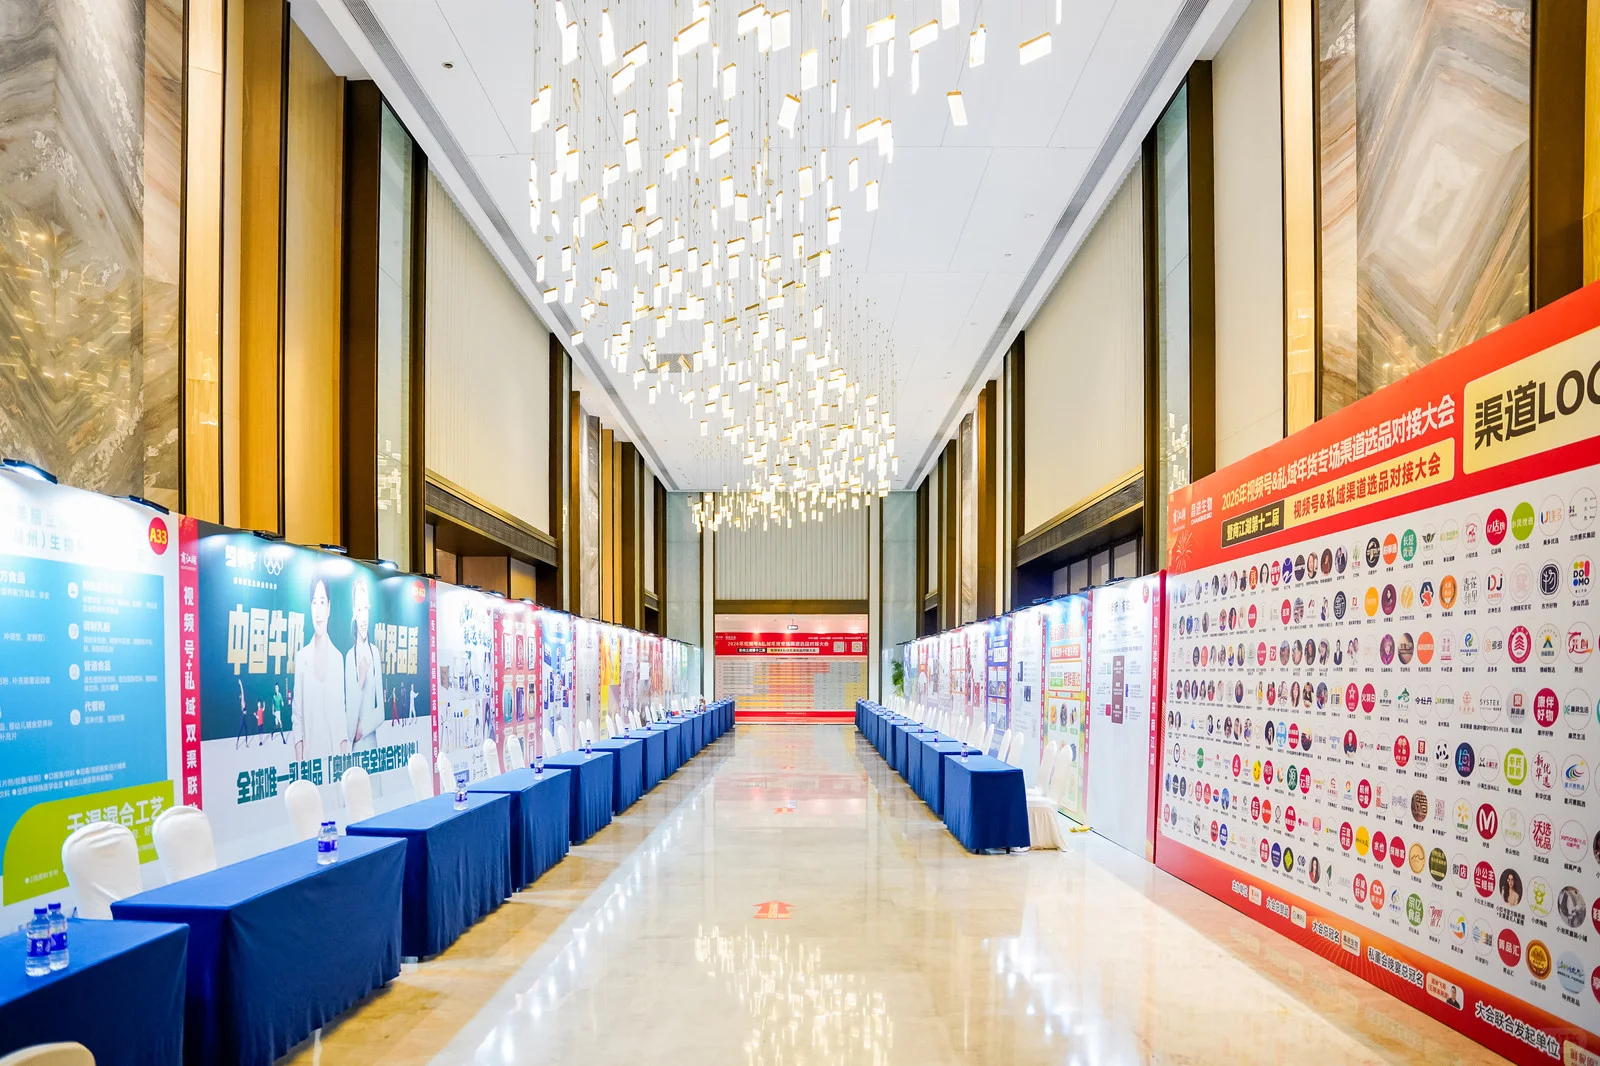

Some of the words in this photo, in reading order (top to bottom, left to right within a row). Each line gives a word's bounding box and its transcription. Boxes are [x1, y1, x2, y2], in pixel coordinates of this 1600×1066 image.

[1222, 394, 1455, 511] 2026年视频号&私域年货专场渠道选品对接大会
[1294, 452, 1441, 520] 视频号&私域渠道选品对接大会
[150, 527, 167, 545] A33
[1226, 508, 1280, 541] 暨商江湖第十二届
[227, 604, 305, 675] 中国牛奶
[183, 586, 199, 810] 视频号+私域双渠联
[1537, 709, 1554, 722] 好物
[1535, 793, 1551, 801] 新华优选
[1533, 820, 1551, 840] 沃选
[1536, 836, 1551, 850] 优品
[1475, 868, 1494, 880] 小公主
[1312, 919, 1340, 944] 大会总冠名
[1368, 946, 1424, 989] 私董会晚宴总冠名
[1475, 1000, 1560, 1060] 大会联合发起单位
